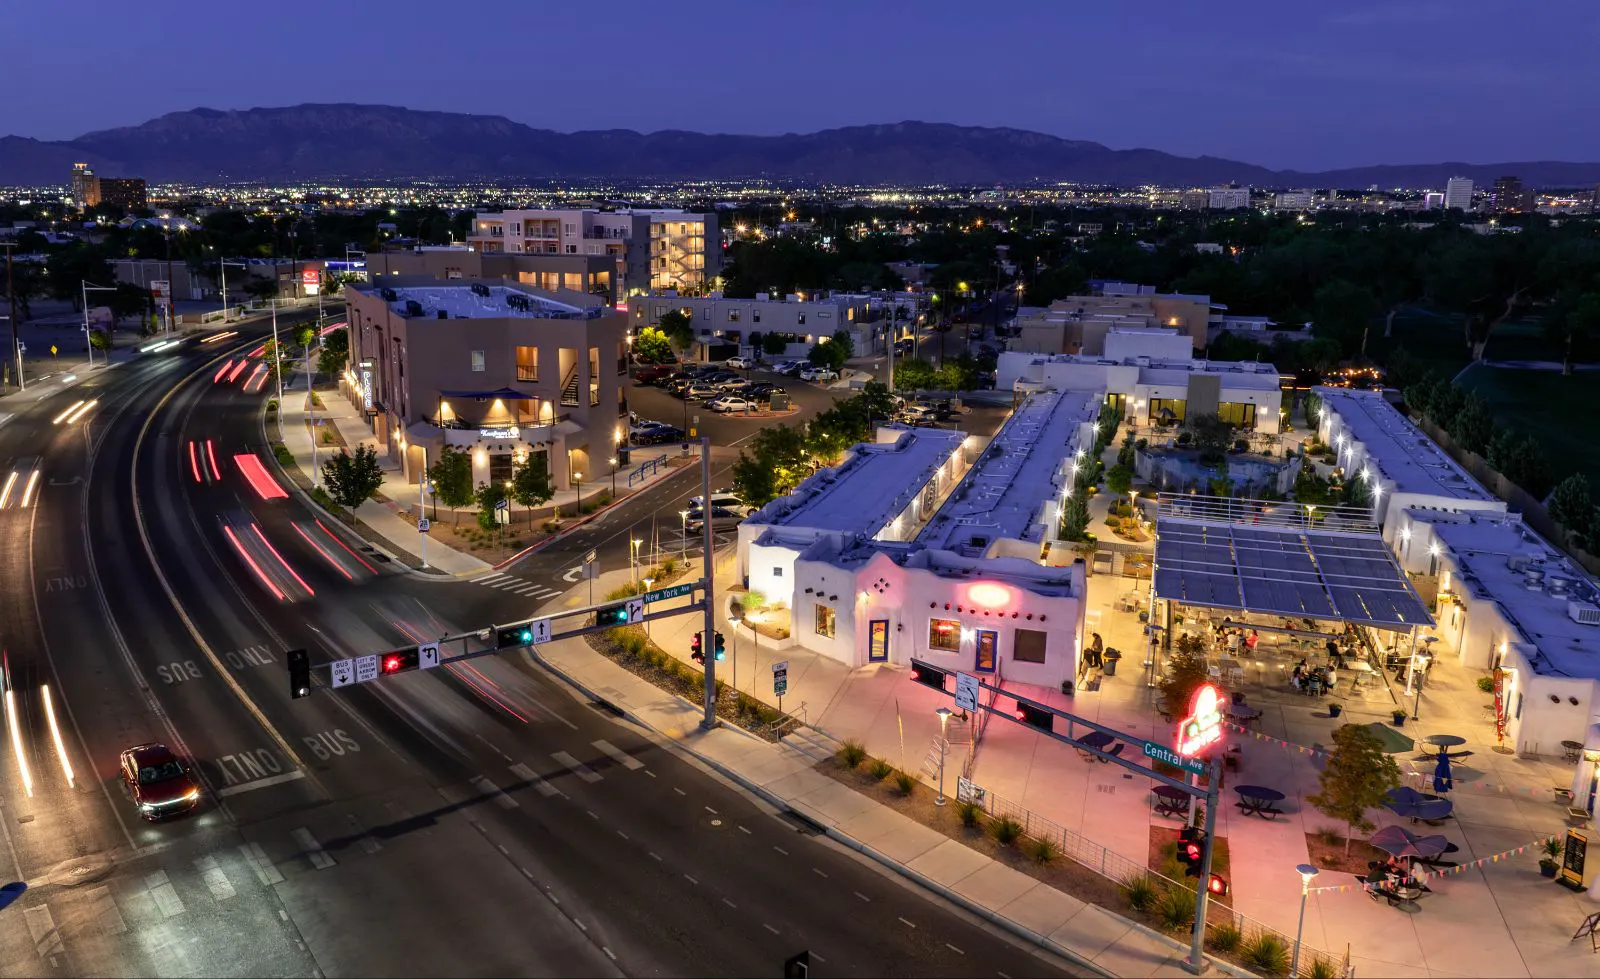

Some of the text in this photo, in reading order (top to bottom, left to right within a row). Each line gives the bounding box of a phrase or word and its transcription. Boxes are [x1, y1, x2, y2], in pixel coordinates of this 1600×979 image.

[45, 575, 87, 593] ONLY
[645, 592, 660, 602] New
[662, 588, 678, 598] York
[535, 635, 549, 643] ONLY
[225, 644, 279, 670] ONLY
[156, 660, 204, 684] BUS
[334, 667, 350, 676] ONLY
[301, 728, 361, 761] BUS
[1144, 743, 1202, 770] Central Ave
[215, 748, 282, 785] ONLY
